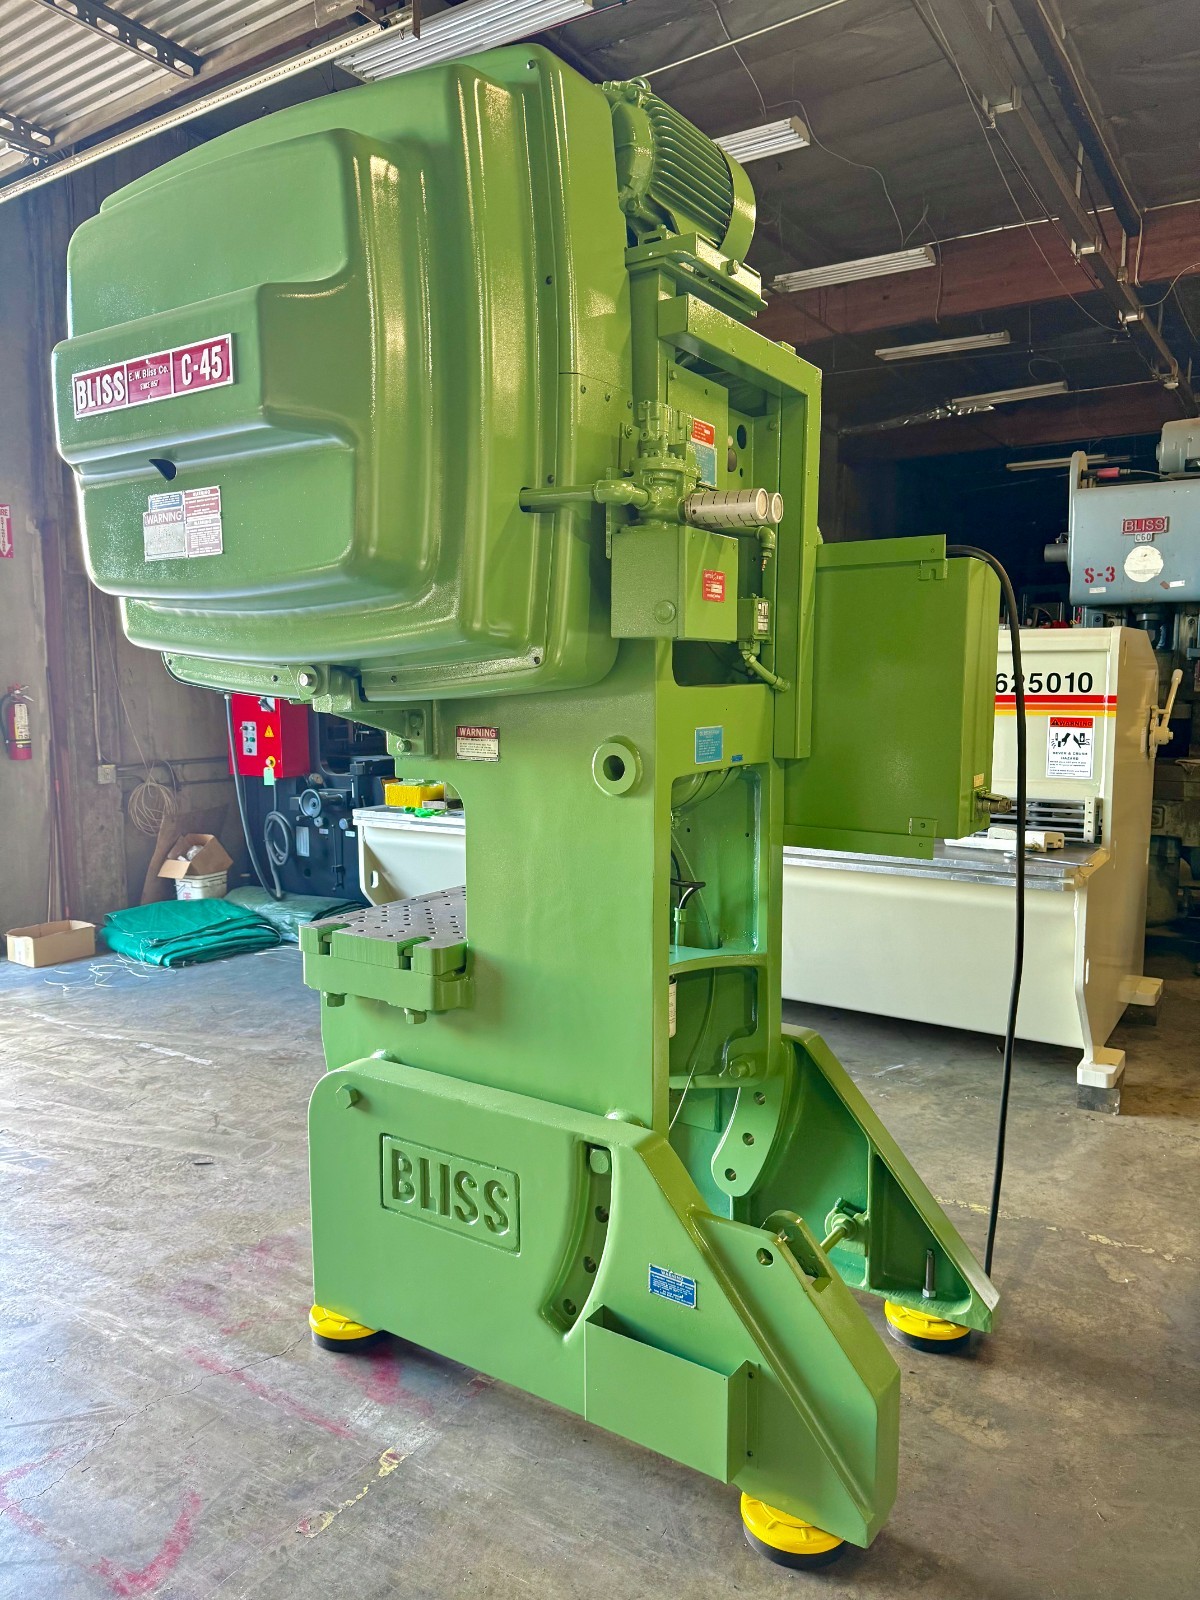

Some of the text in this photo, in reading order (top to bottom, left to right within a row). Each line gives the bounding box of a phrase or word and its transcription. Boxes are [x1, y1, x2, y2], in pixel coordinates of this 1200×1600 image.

[181, 345, 223, 386] C-45
[142, 368, 157, 379] Bliss
[76, 371, 126, 410] BLISS
[146, 511, 182, 525] WARNING
[1124, 518, 1164, 532] BLISS
[1135, 533, 1153, 542] C60
[1084, 566, 1116, 584] S-3
[1059, 720, 1093, 728] WARNING
[459, 727, 496, 738] WARNING
[391, 1148, 510, 1236] BLISS
